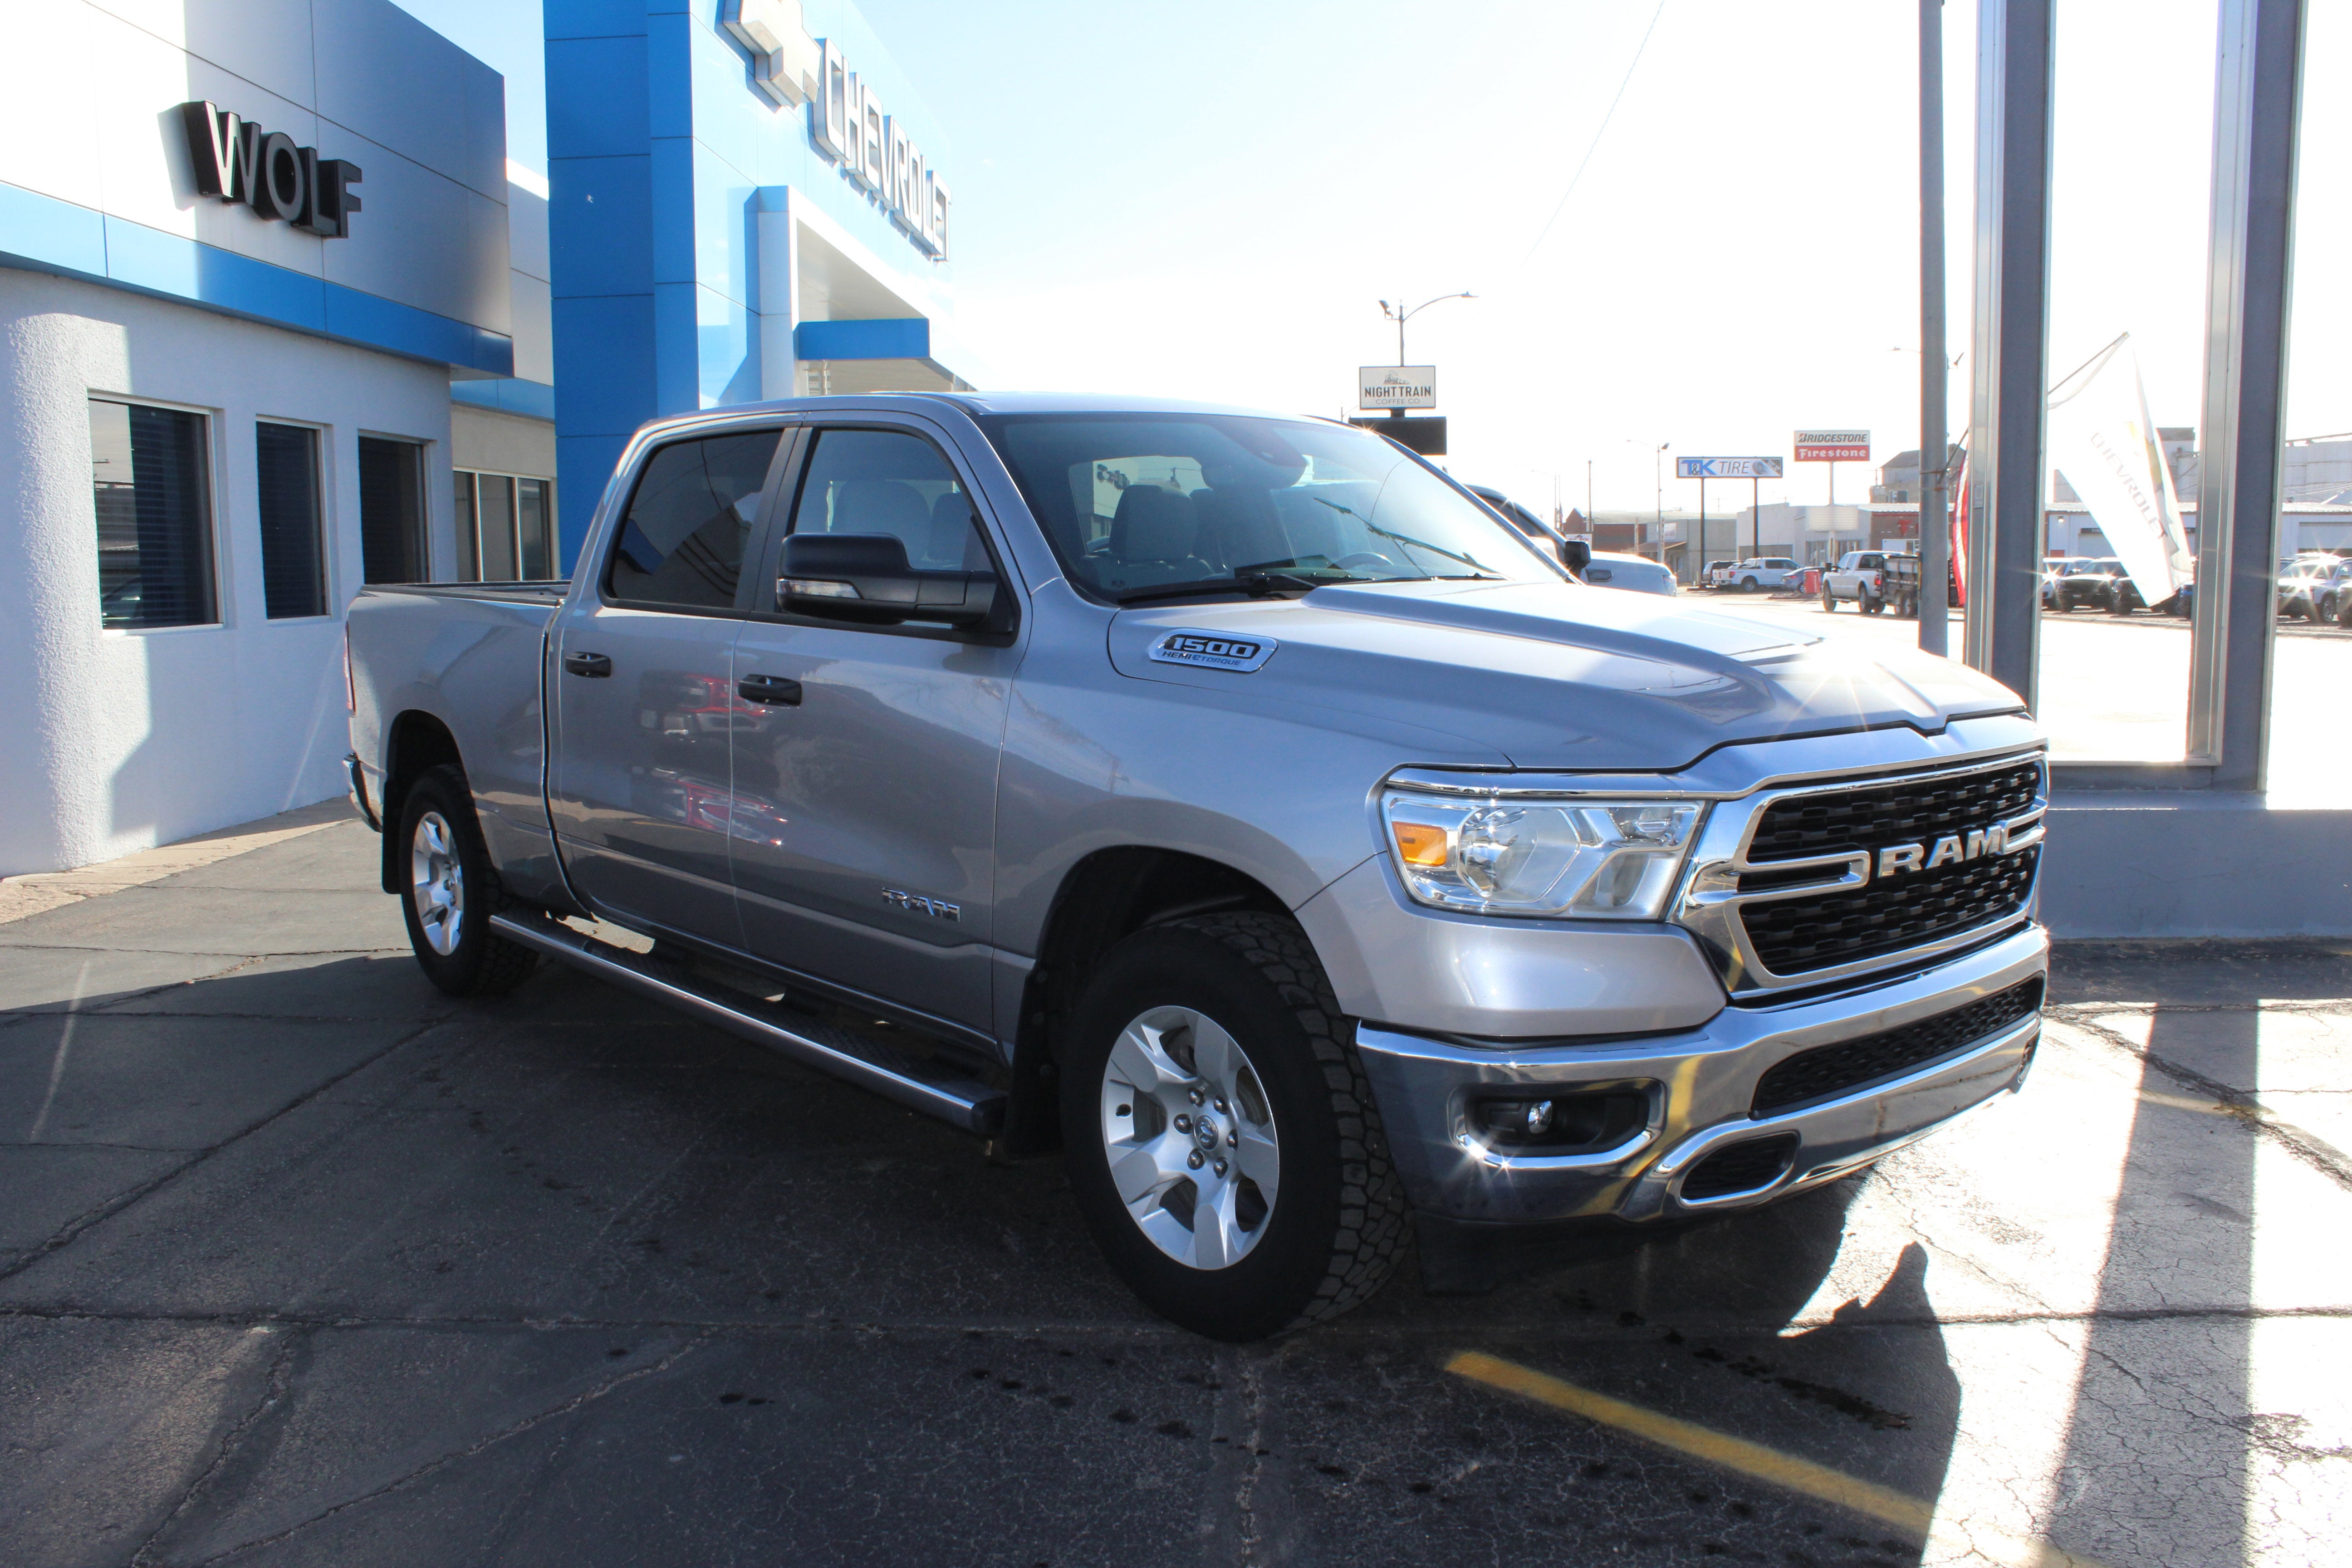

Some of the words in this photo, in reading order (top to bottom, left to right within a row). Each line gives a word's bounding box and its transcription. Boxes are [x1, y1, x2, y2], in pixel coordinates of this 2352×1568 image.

[822, 37, 952, 262] CHEVROLET
[201, 100, 362, 239] WOLF
[1364, 387, 1397, 397] NIGHT
[1399, 386, 1431, 397] TRAIN
[1798, 433, 1867, 443] BRIDGESTONE
[1798, 448, 1866, 459] Firestone
[1719, 461, 1750, 474] TIRE
[1173, 637, 1255, 657] 1500
[1162, 651, 1191, 660] HEMI
[1877, 825, 2002, 878] RAM
